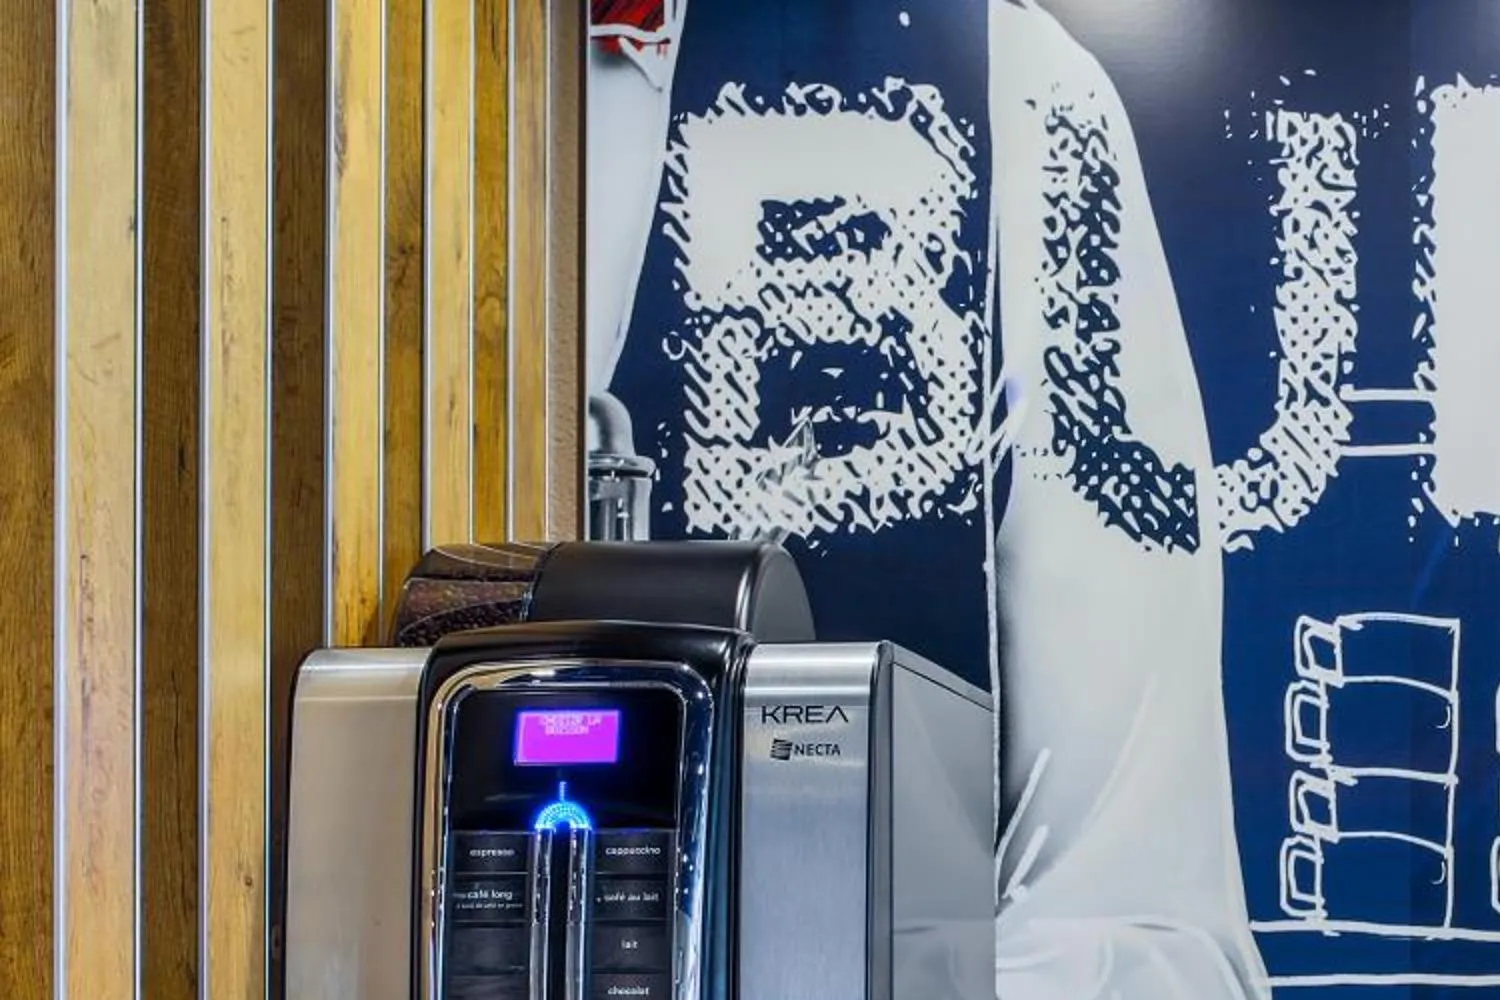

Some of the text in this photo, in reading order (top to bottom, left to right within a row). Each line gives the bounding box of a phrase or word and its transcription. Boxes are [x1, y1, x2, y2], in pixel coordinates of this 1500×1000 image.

[761, 705, 849, 724] KREA
[794, 743, 841, 756] NECTA
[605, 846, 661, 857] cappuccino
[491, 888, 513, 900] long
